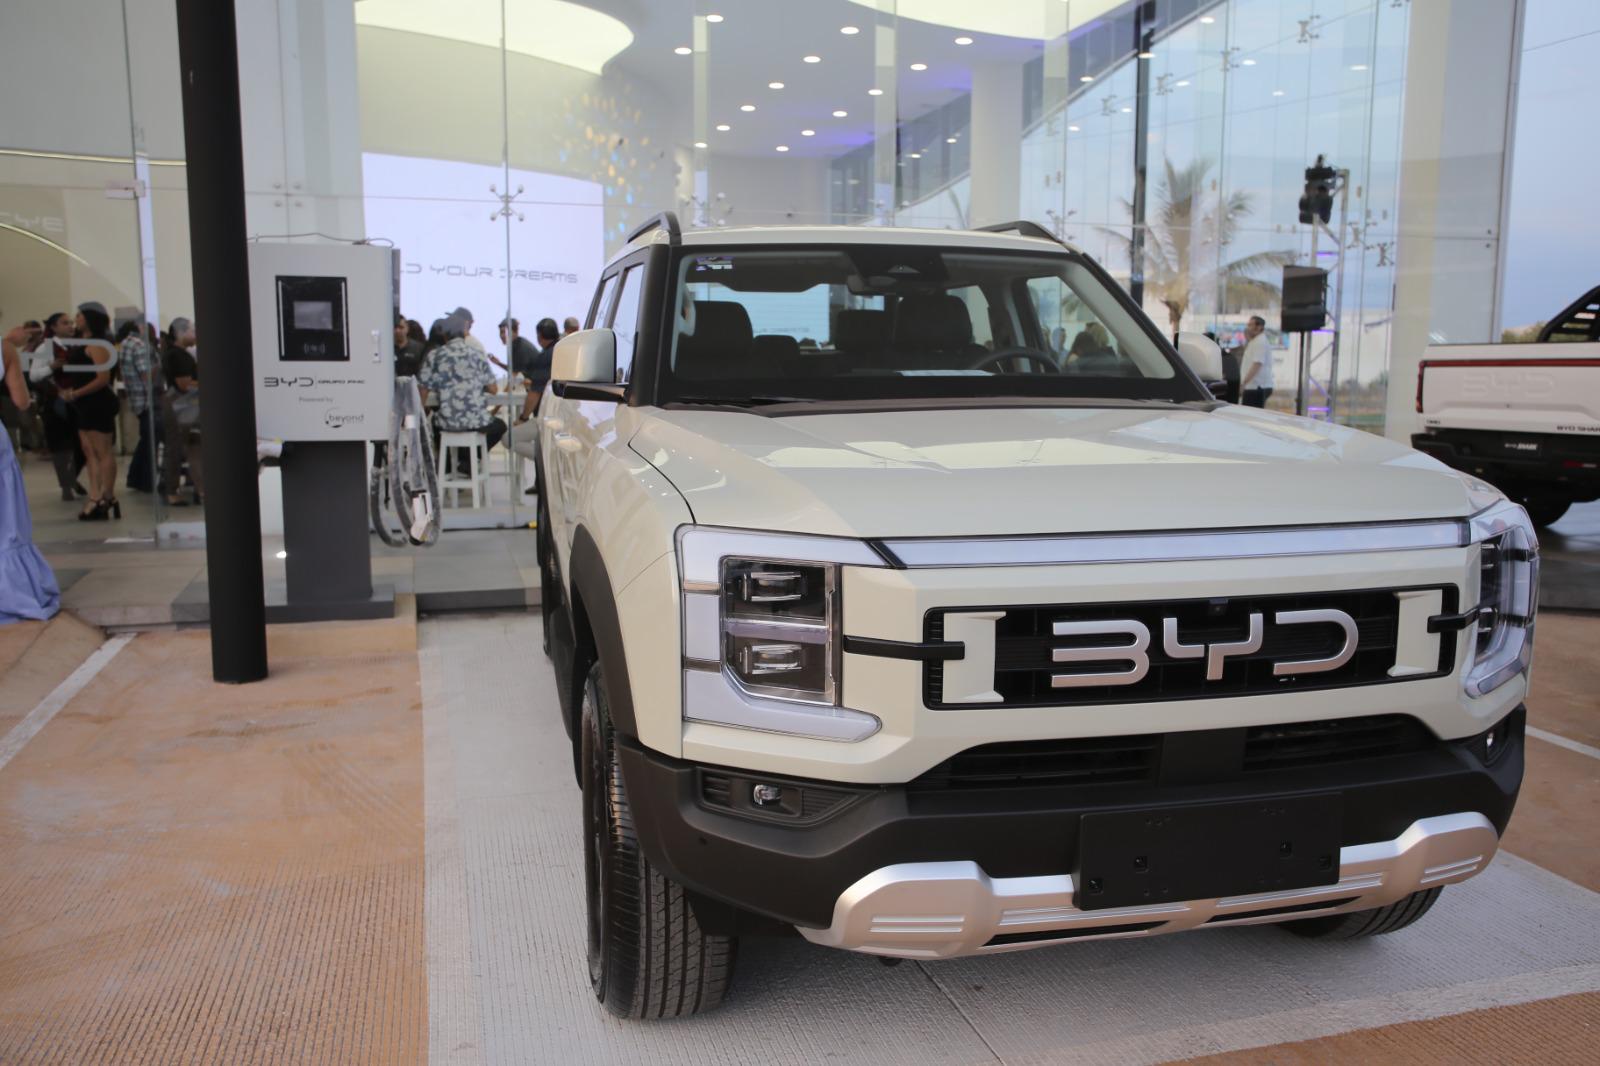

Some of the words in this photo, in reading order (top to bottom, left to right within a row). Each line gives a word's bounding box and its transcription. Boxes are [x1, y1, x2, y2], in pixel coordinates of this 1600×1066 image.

[430, 264, 493, 277] YOUR
[264, 376, 314, 387] BYD
[1463, 371, 1555, 399] BYD
[328, 413, 364, 424] beyond
[1051, 608, 1359, 688] BYD
